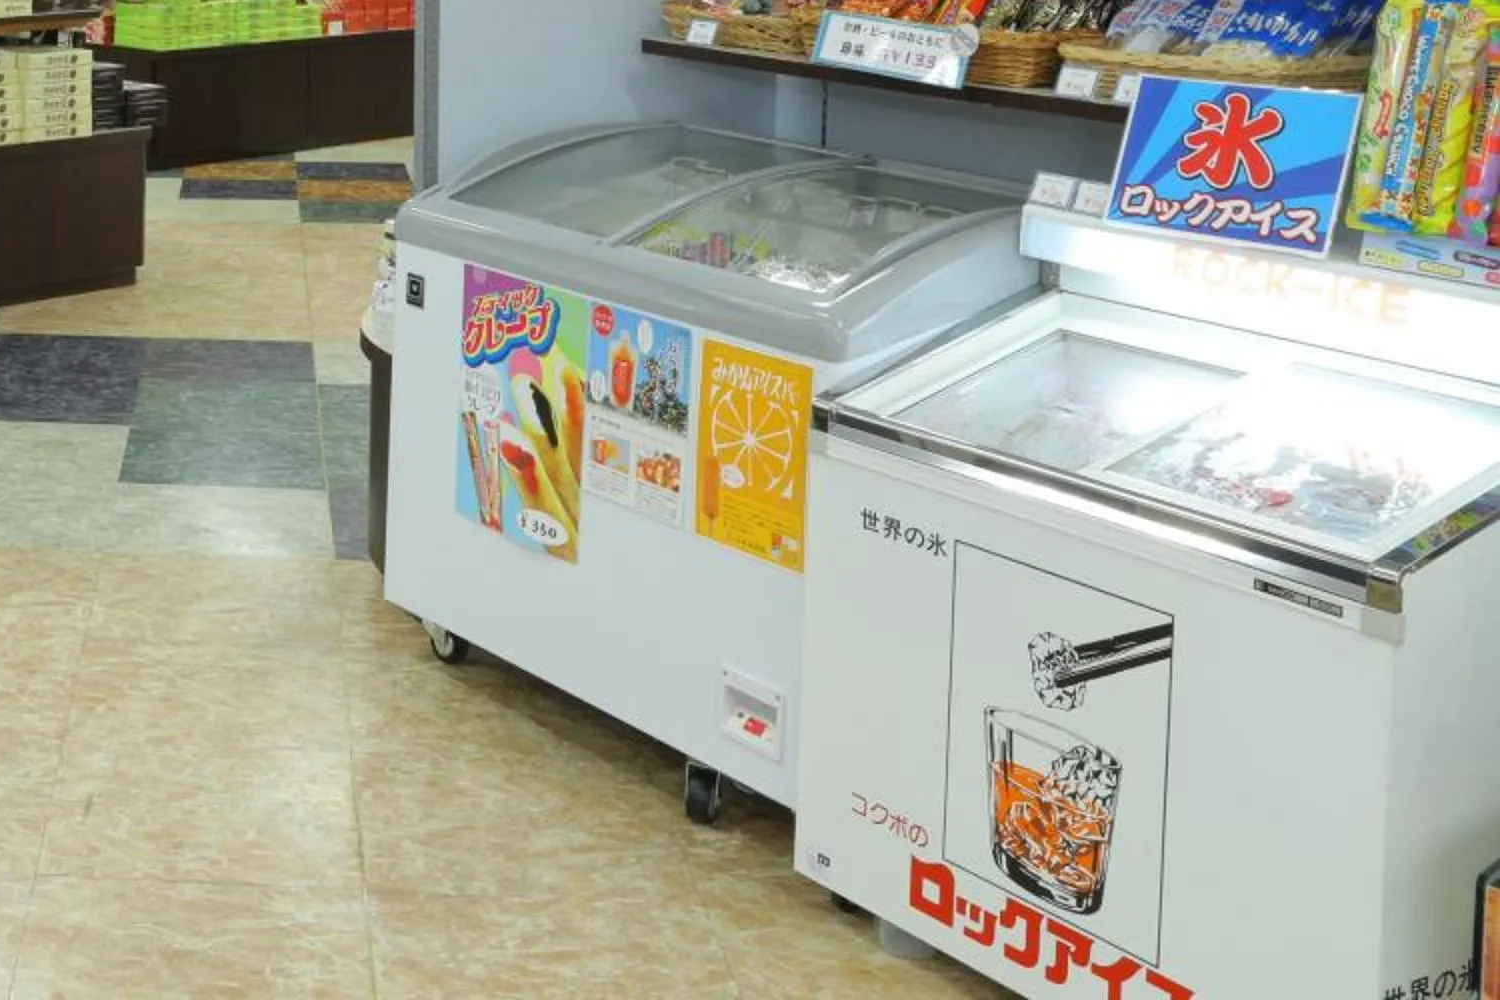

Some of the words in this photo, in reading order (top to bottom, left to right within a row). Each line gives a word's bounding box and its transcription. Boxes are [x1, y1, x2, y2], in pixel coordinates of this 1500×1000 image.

[1177, 93, 1283, 189] 氷
[1120, 185, 1319, 244] ロックアイス
[465, 301, 552, 355] クレープ
[860, 508, 947, 556] 世界の氷
[852, 792, 929, 847] コクボの
